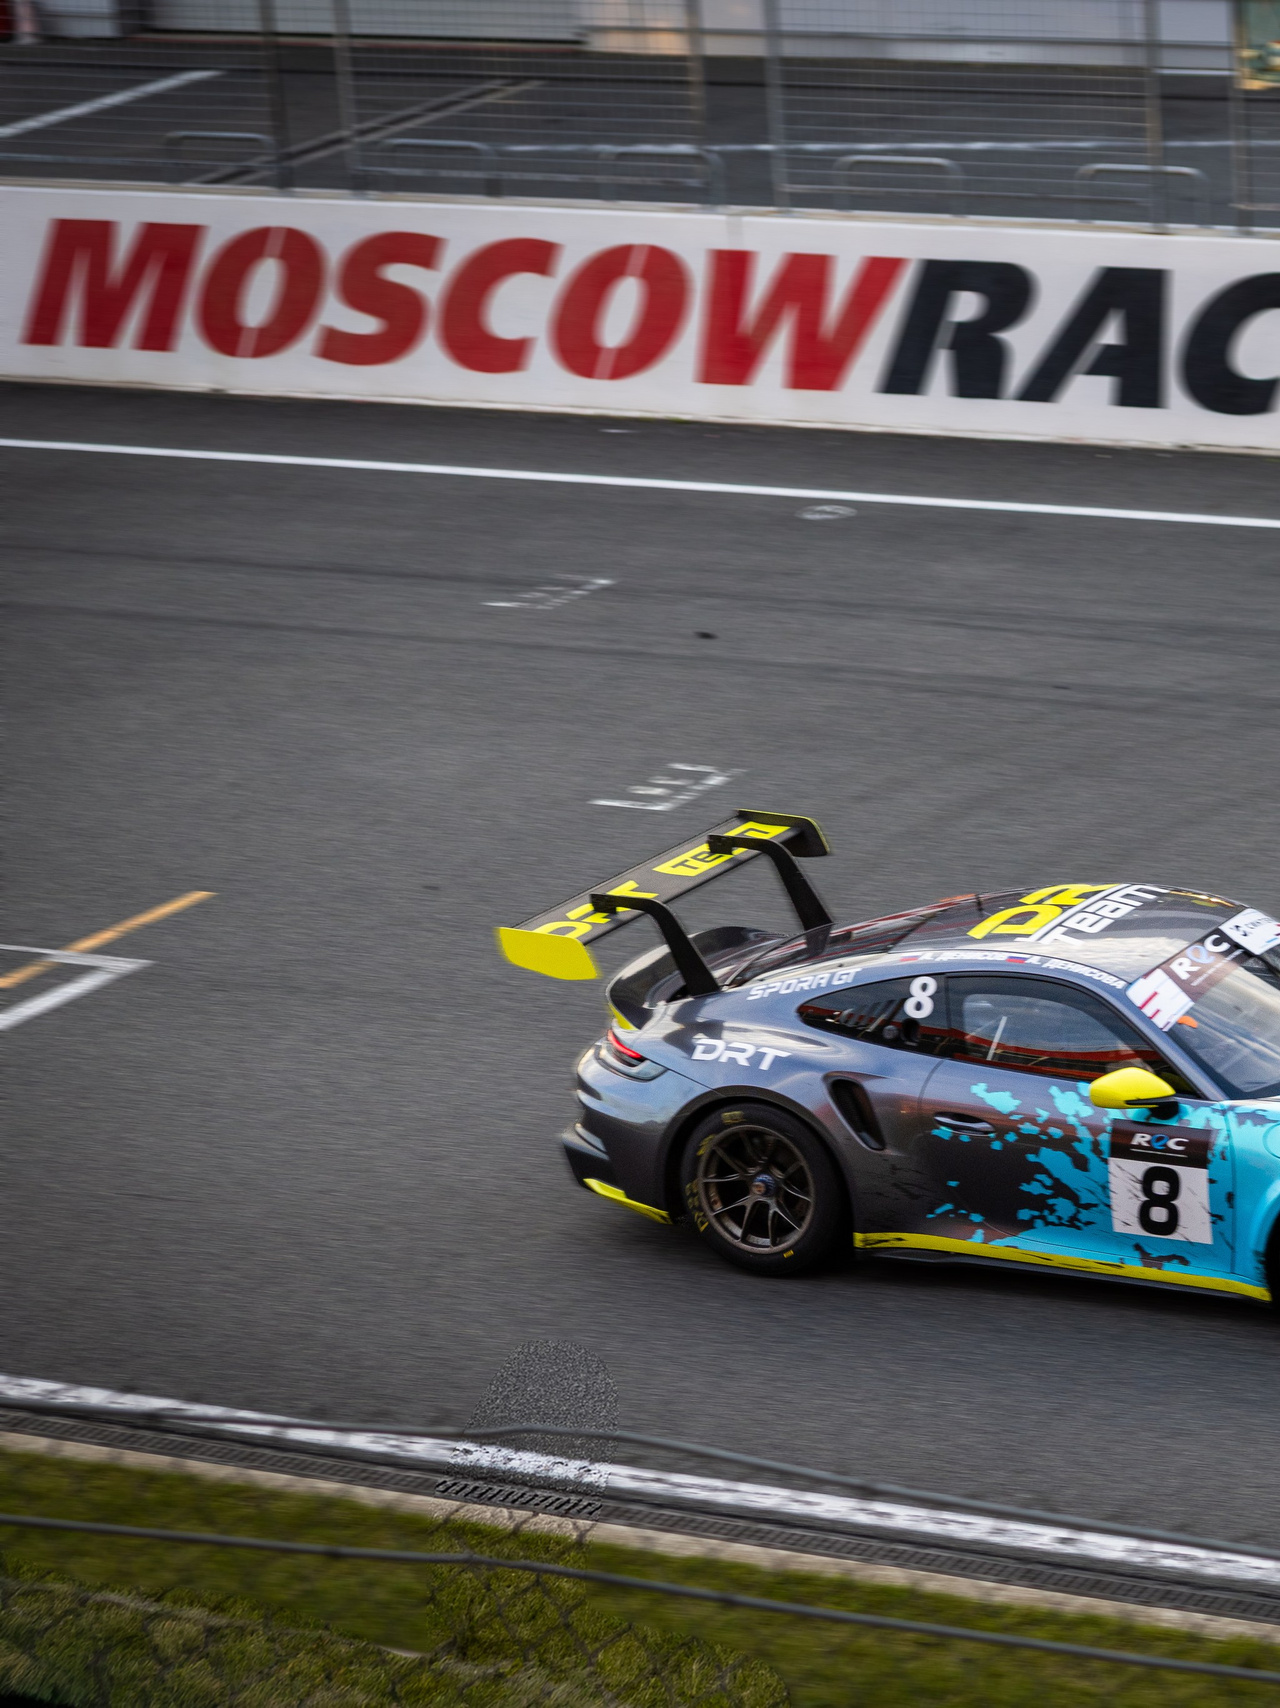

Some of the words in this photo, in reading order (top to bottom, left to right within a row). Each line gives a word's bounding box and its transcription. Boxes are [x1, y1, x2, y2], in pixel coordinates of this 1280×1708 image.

[746, 973, 830, 1001] SPORA
[831, 968, 863, 985] GT
[903, 975, 938, 1019] 8
[690, 1037, 793, 1071] DRT
[1138, 1165, 1181, 1236] 8
